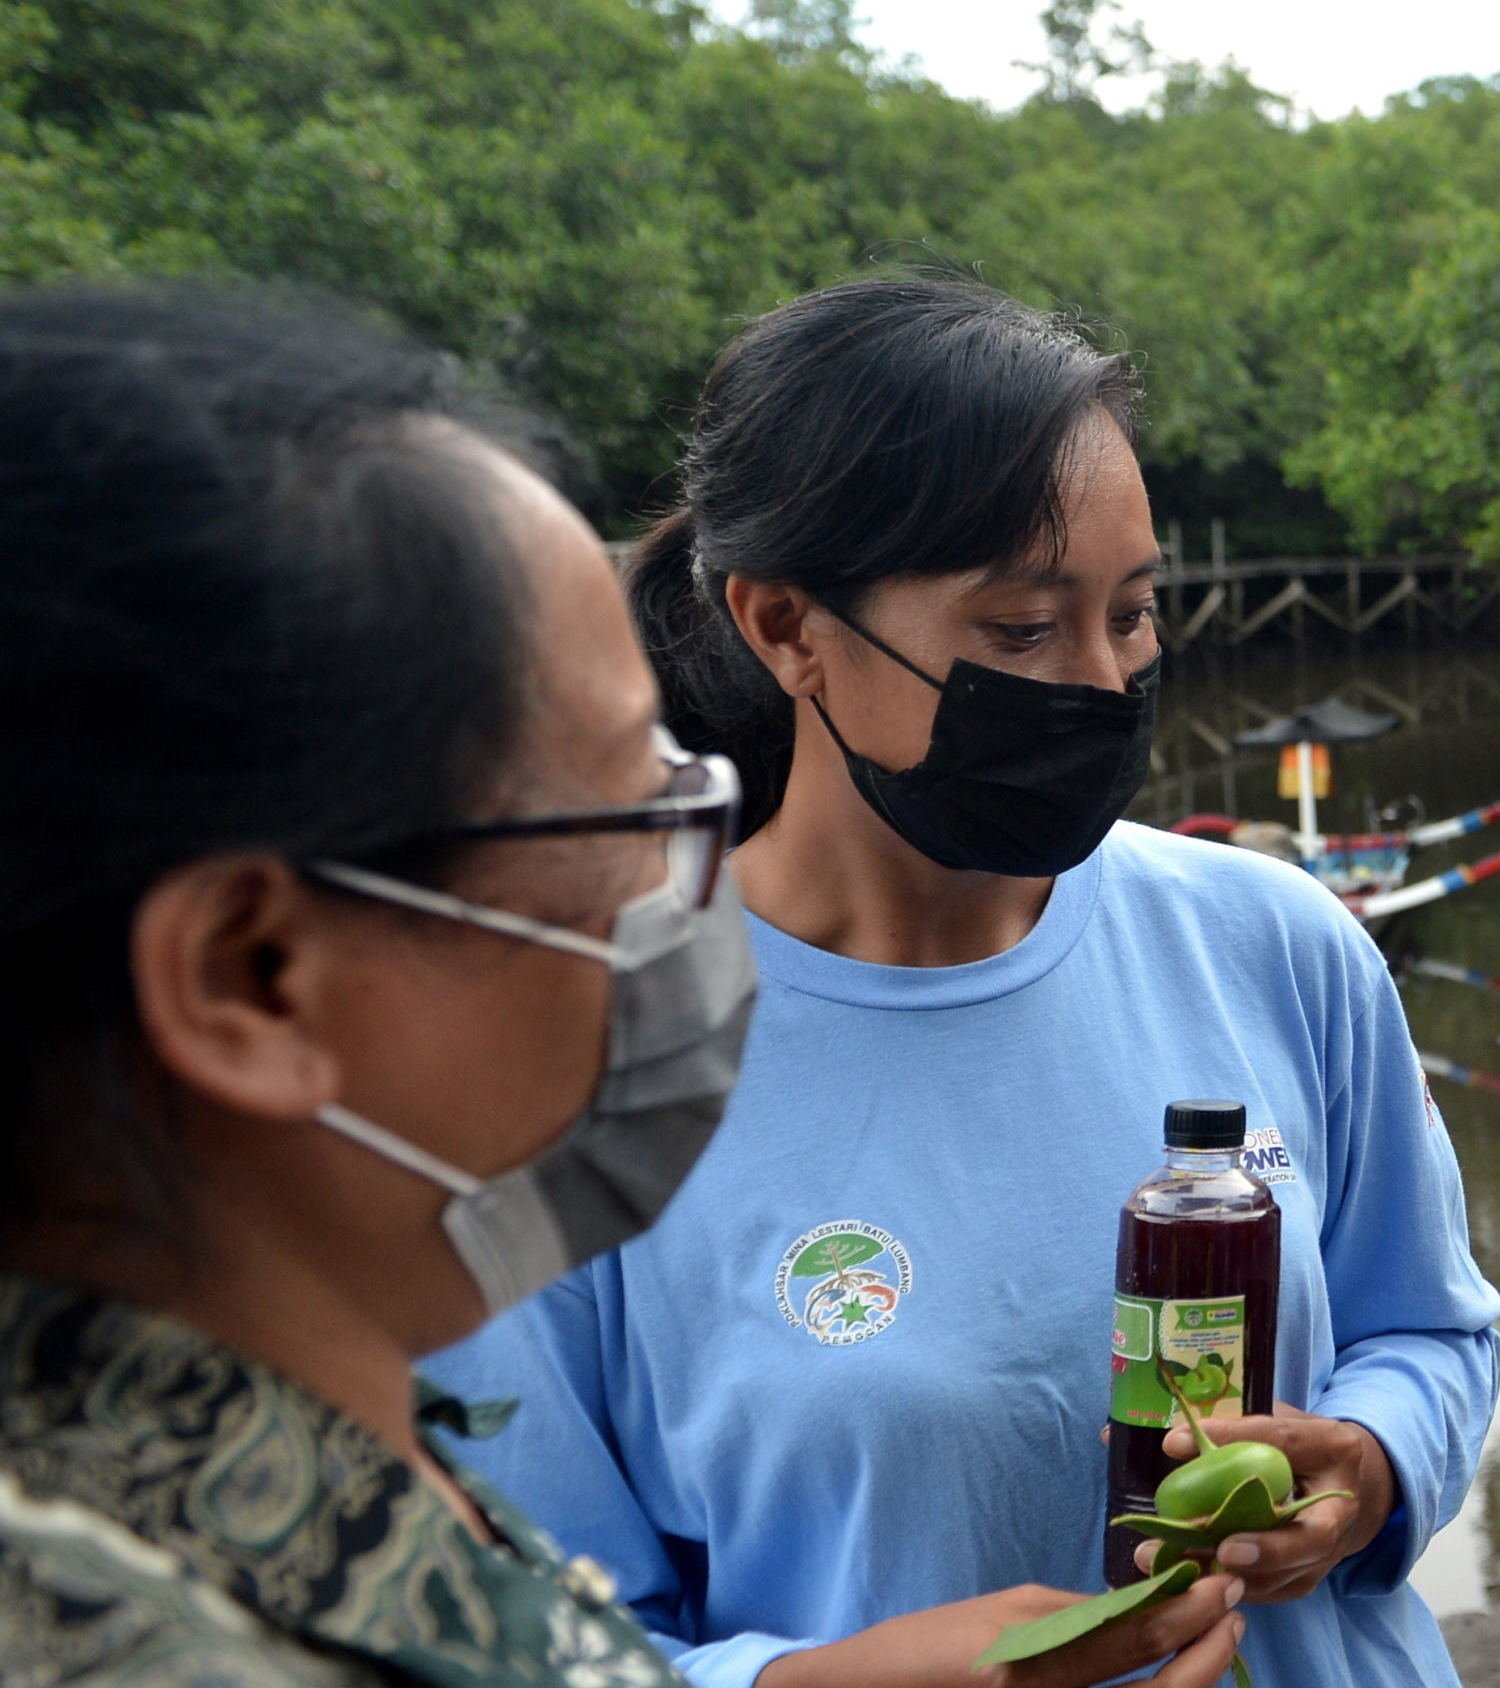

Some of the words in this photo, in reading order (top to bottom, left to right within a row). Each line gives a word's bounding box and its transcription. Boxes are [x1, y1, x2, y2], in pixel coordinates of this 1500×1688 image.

[811, 1223, 859, 1239] LESTARI
[863, 1226, 889, 1243] BATU
[785, 1239, 809, 1262] MINA
[891, 1243, 909, 1294] LUMBANG
[775, 1265, 800, 1328] POKLAHSAR
